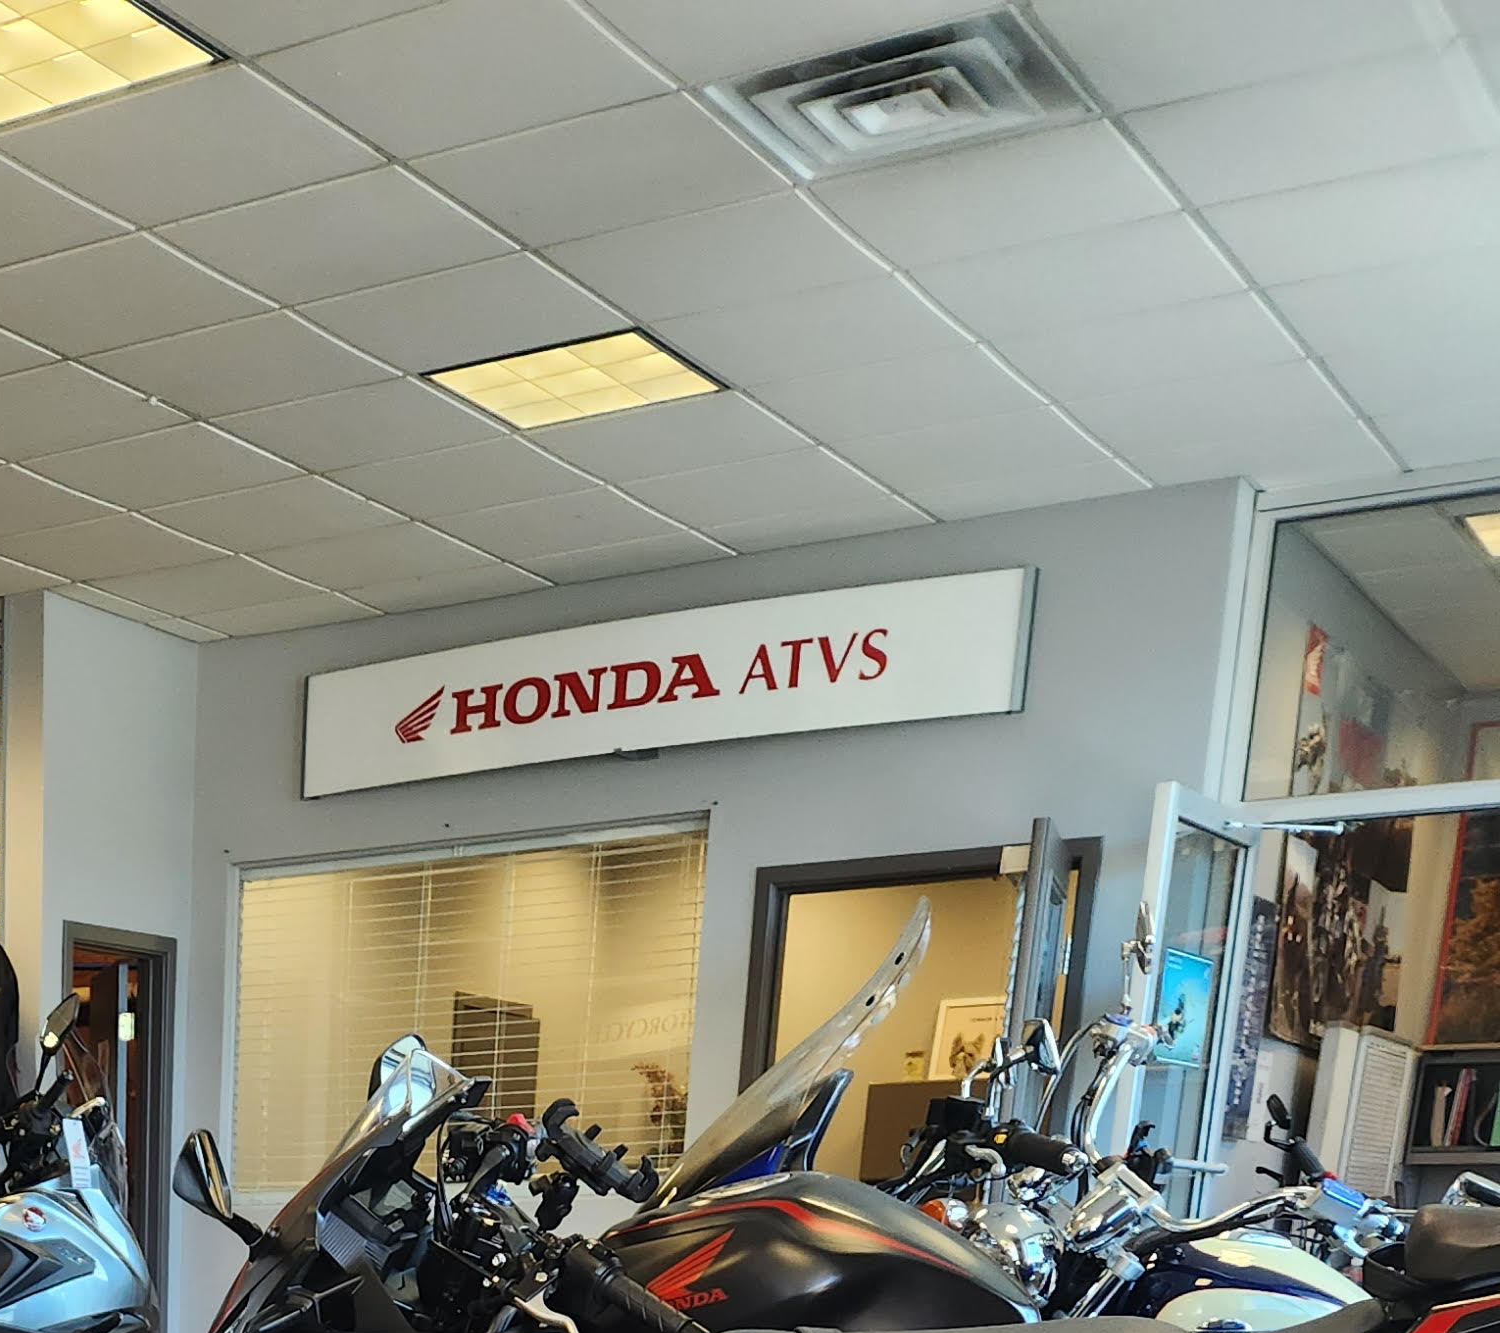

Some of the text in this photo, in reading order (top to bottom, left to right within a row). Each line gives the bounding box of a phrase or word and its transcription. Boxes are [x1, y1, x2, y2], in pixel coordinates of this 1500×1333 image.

[450, 628, 889, 735] HONDA ATVS
[666, 1288, 730, 1310] NDA
